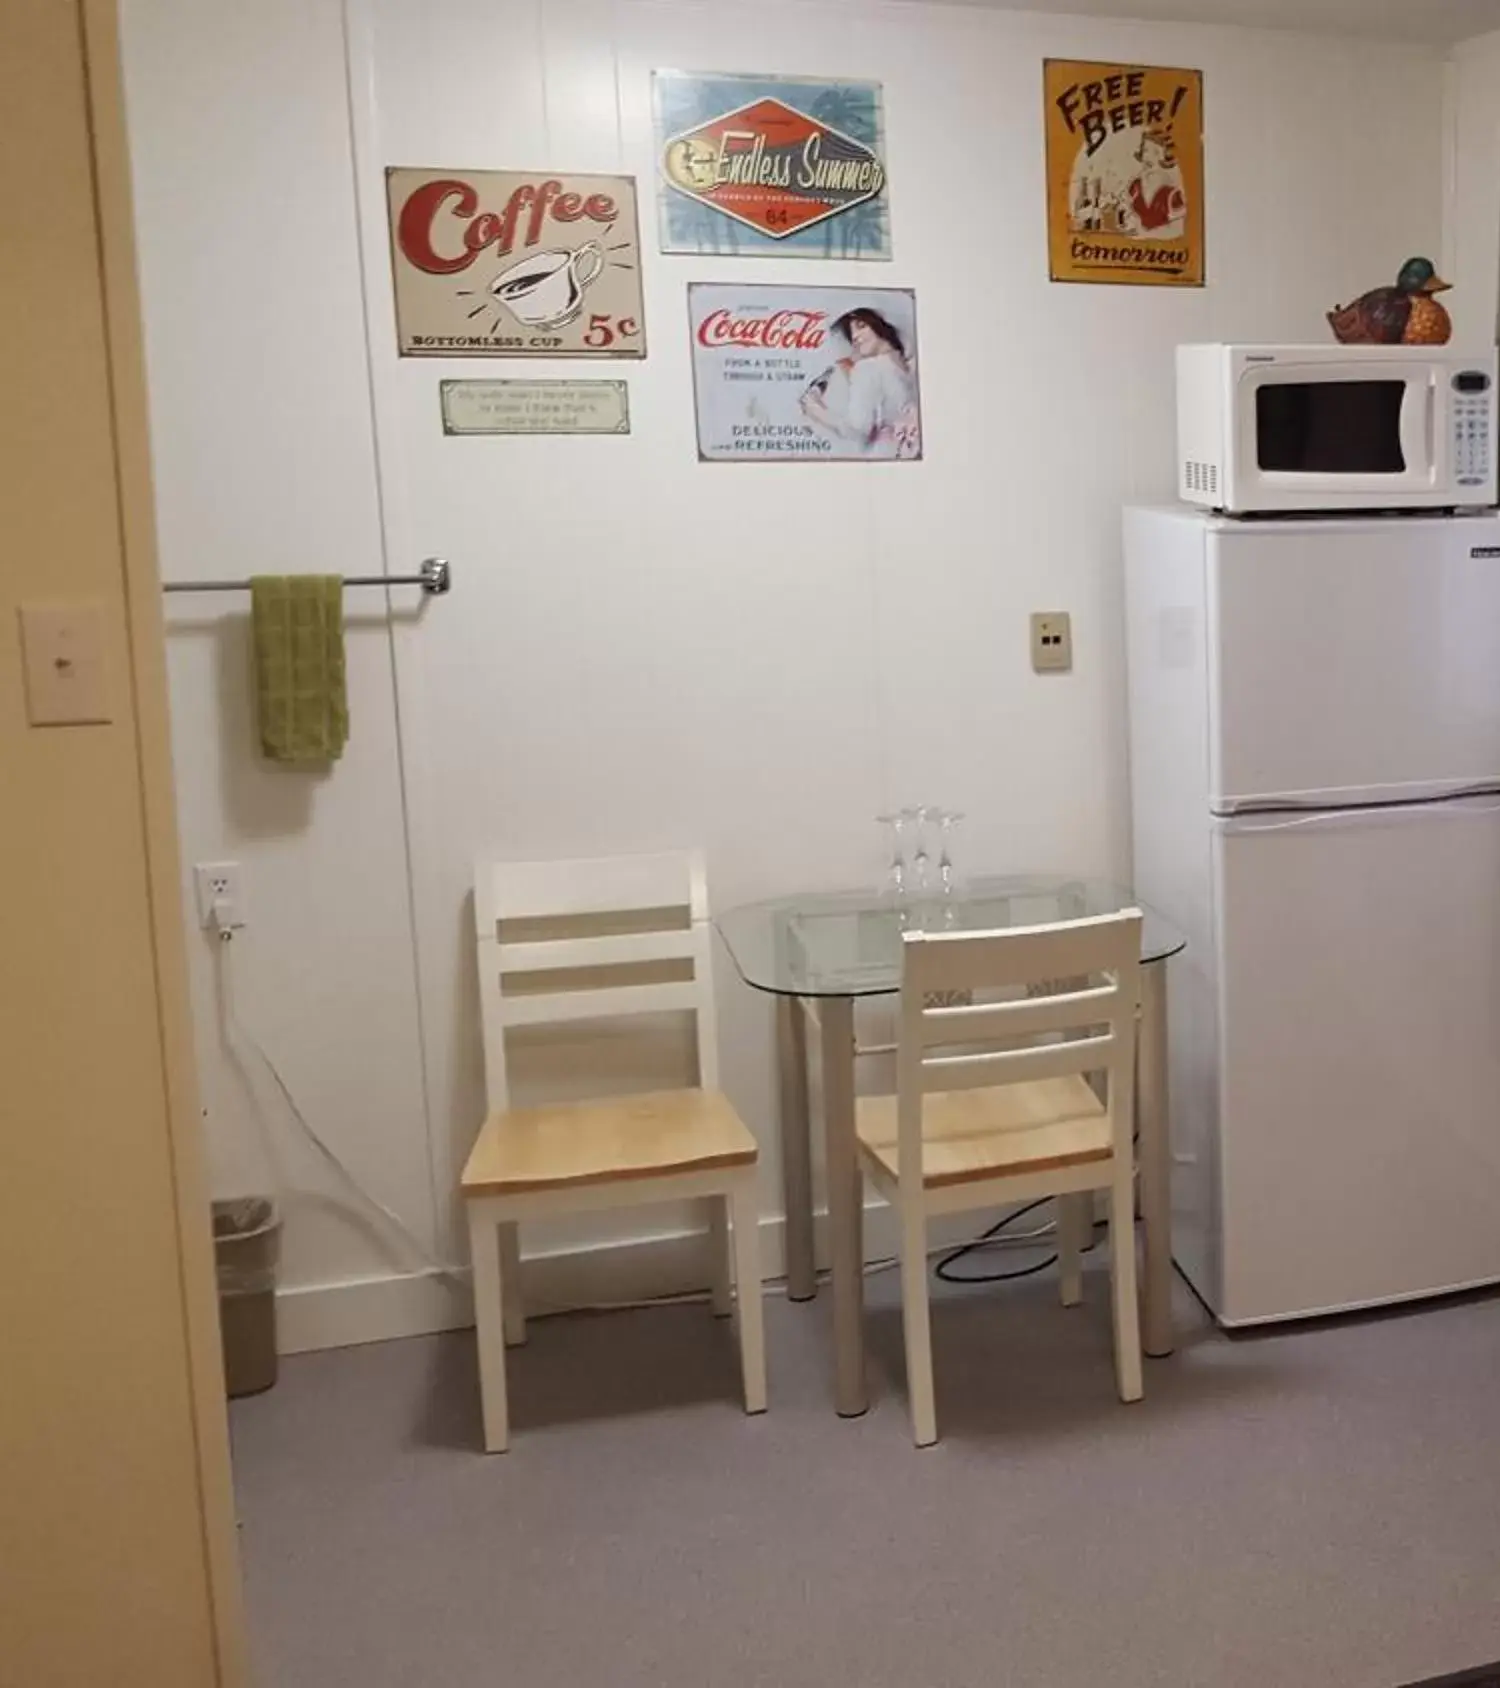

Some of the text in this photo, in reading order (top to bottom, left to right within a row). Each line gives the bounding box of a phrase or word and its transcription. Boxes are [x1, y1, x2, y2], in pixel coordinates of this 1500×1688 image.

[1056, 72, 1144, 134] FREE
[1079, 86, 1188, 157] BEER!
[715, 131, 884, 191] Endless Summer
[399, 180, 618, 274] Coffee
[1072, 238, 1189, 264] tomorrow
[411, 336, 563, 346] BOTTOMLESS CUP
[732, 425, 814, 437] DELICIOUS
[735, 440, 831, 450] REFRESHING
